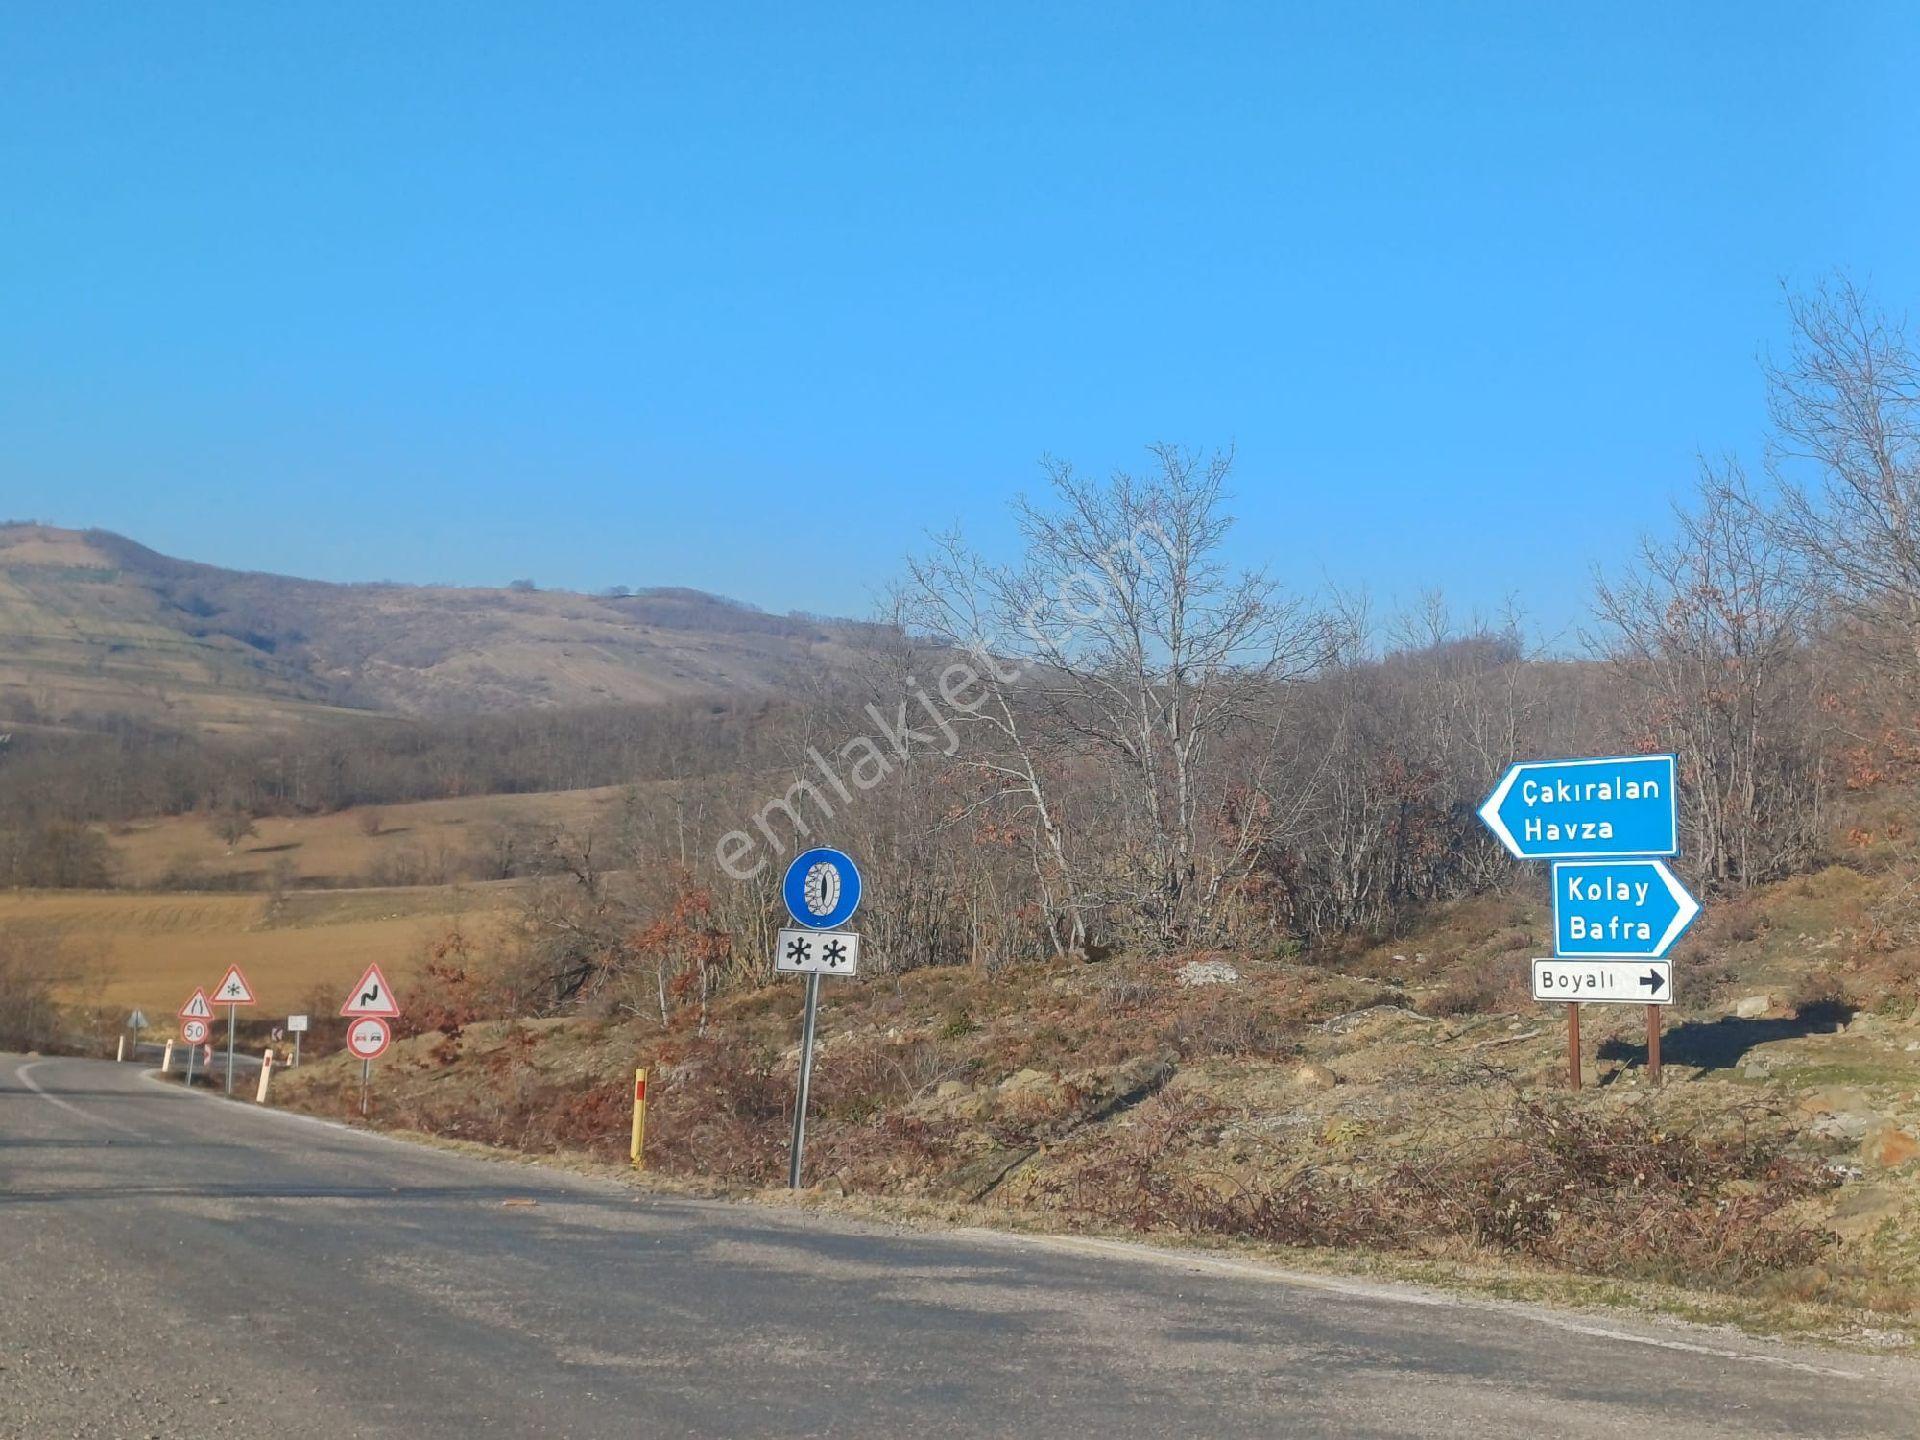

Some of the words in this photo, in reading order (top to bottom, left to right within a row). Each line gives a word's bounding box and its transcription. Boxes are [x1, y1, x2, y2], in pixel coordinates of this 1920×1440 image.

[1522, 776, 1660, 807] Çakıralan
[1525, 817, 1614, 842] Havza
[1568, 876, 1649, 906] Kolay
[1570, 915, 1651, 940] Bafra
[1542, 971, 1614, 992] Boyalı
[186, 1025, 203, 1037] 50
